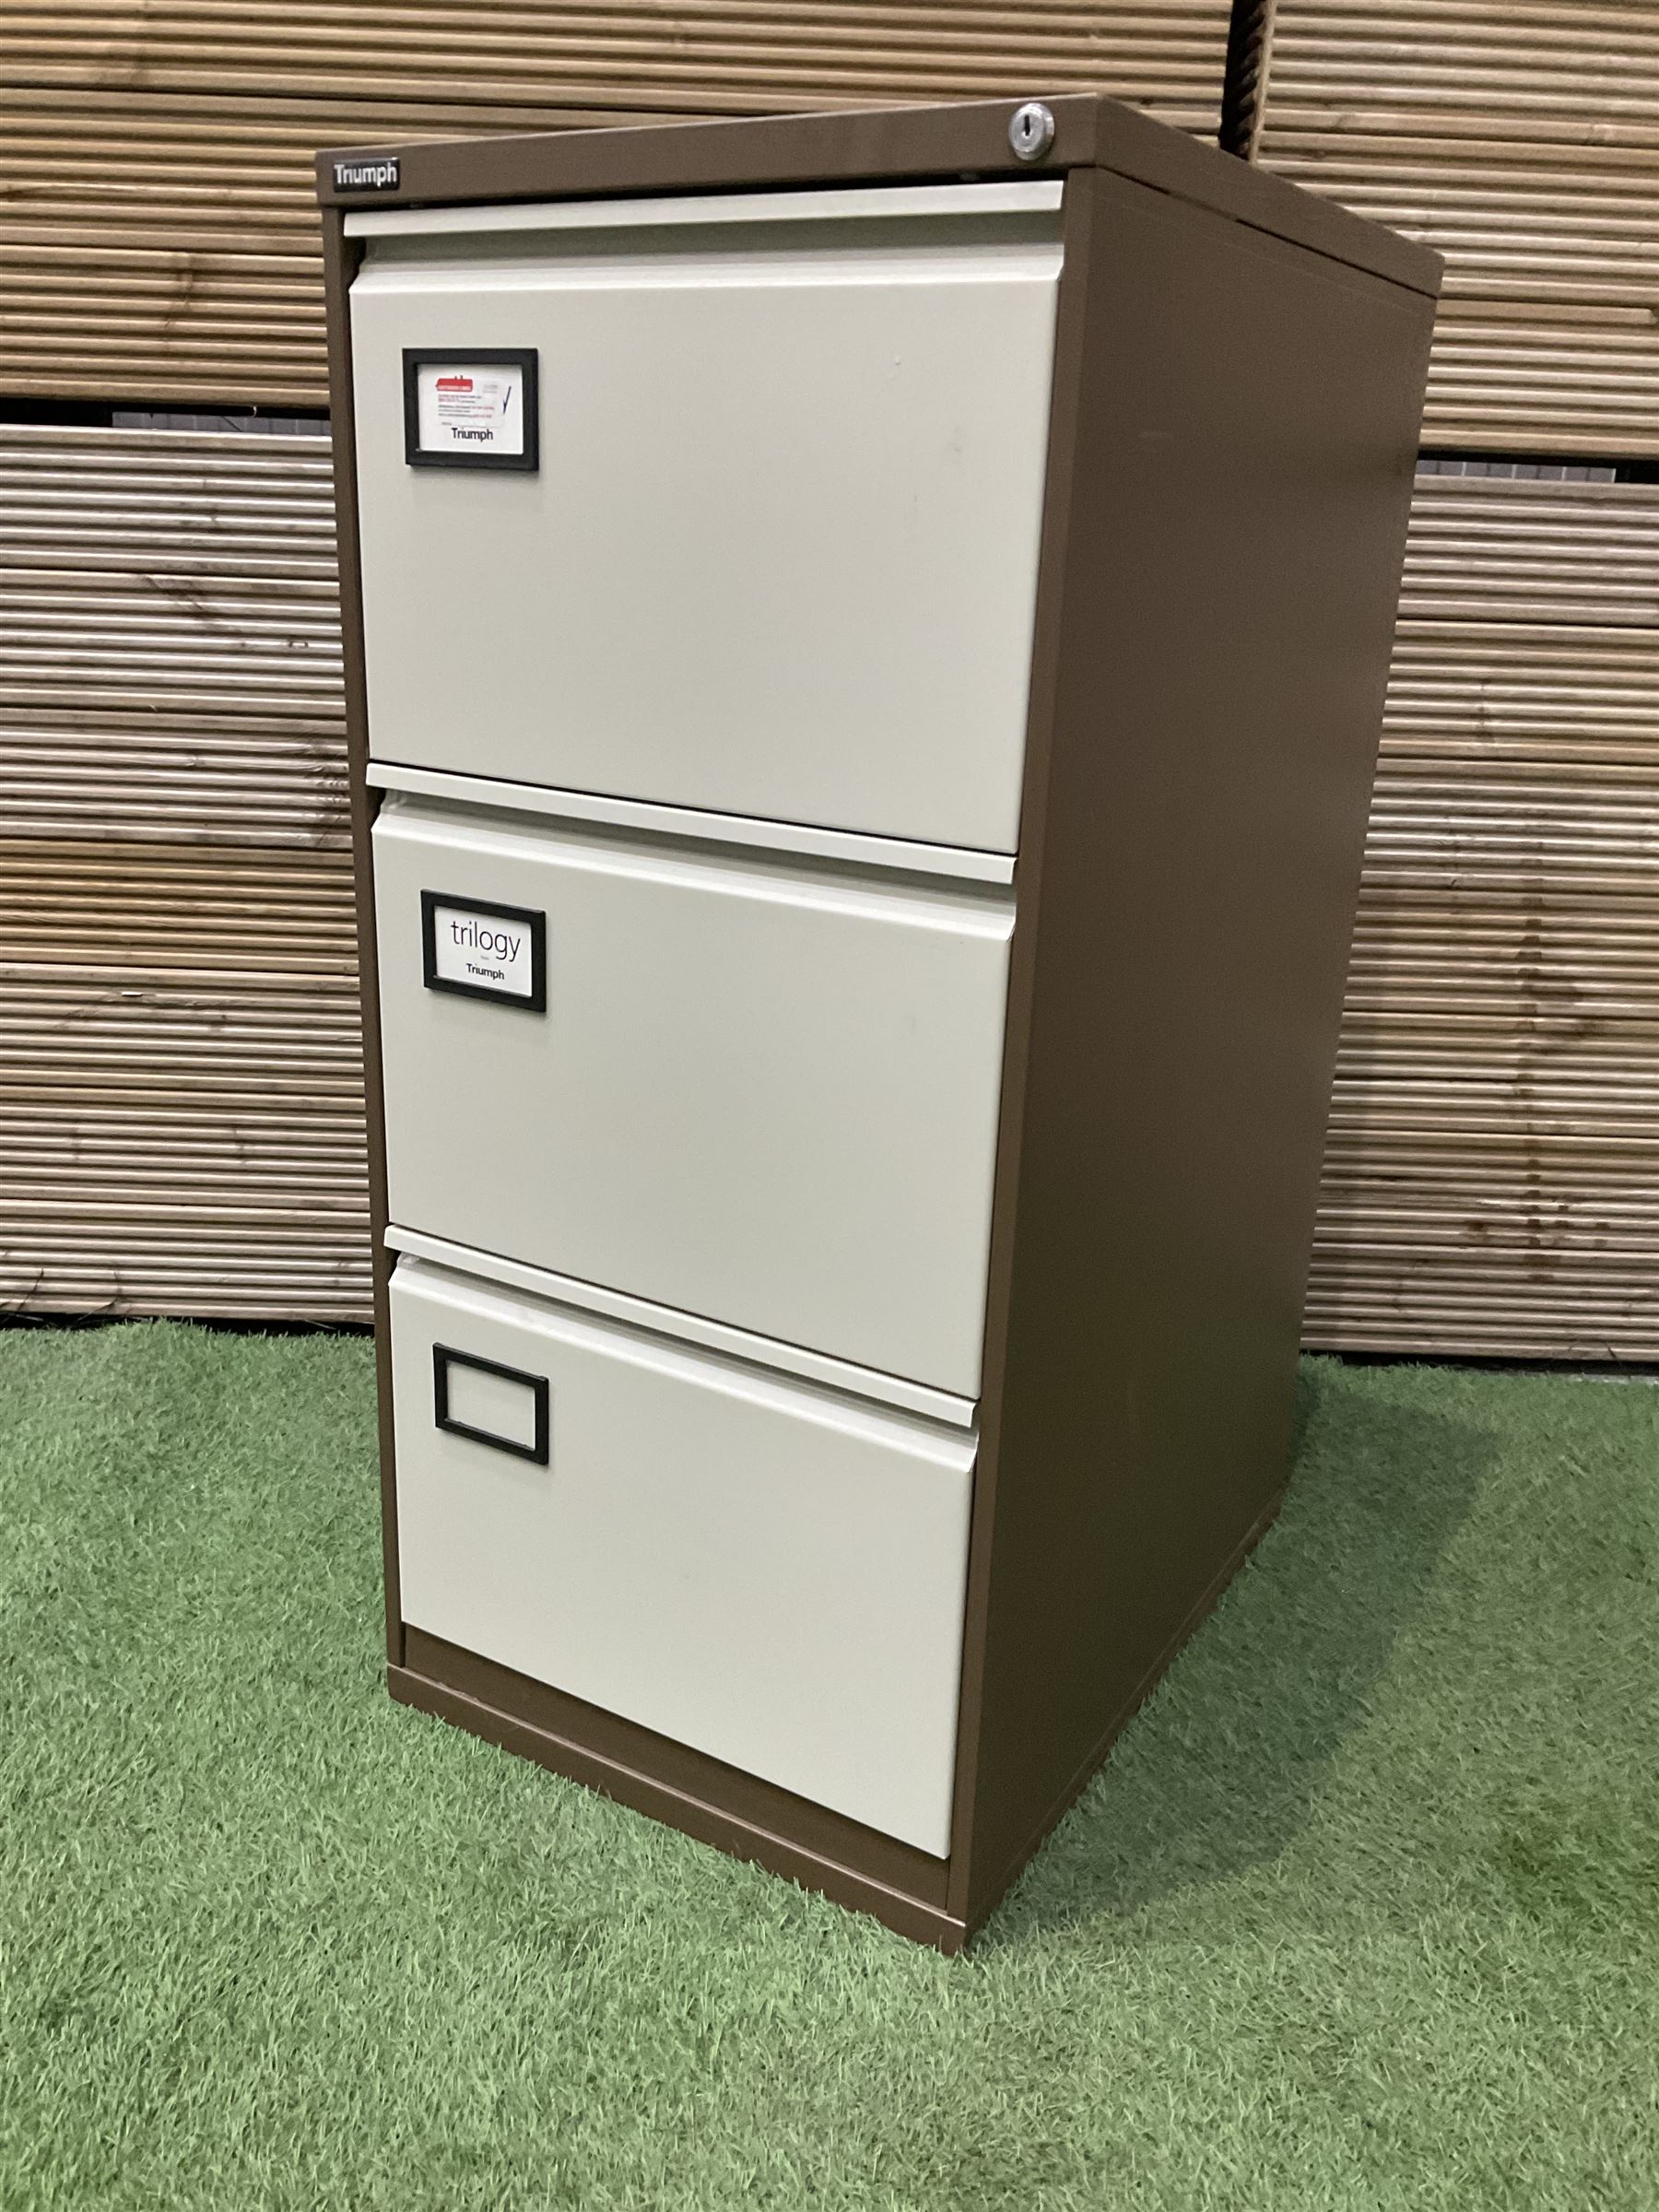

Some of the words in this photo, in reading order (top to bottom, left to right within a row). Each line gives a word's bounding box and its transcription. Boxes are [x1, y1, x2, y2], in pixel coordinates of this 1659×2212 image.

[334, 161, 397, 187] Triumph
[452, 427, 494, 442] Triumph
[451, 921, 521, 962] trilogy
[465, 963, 505, 980] Triumph
